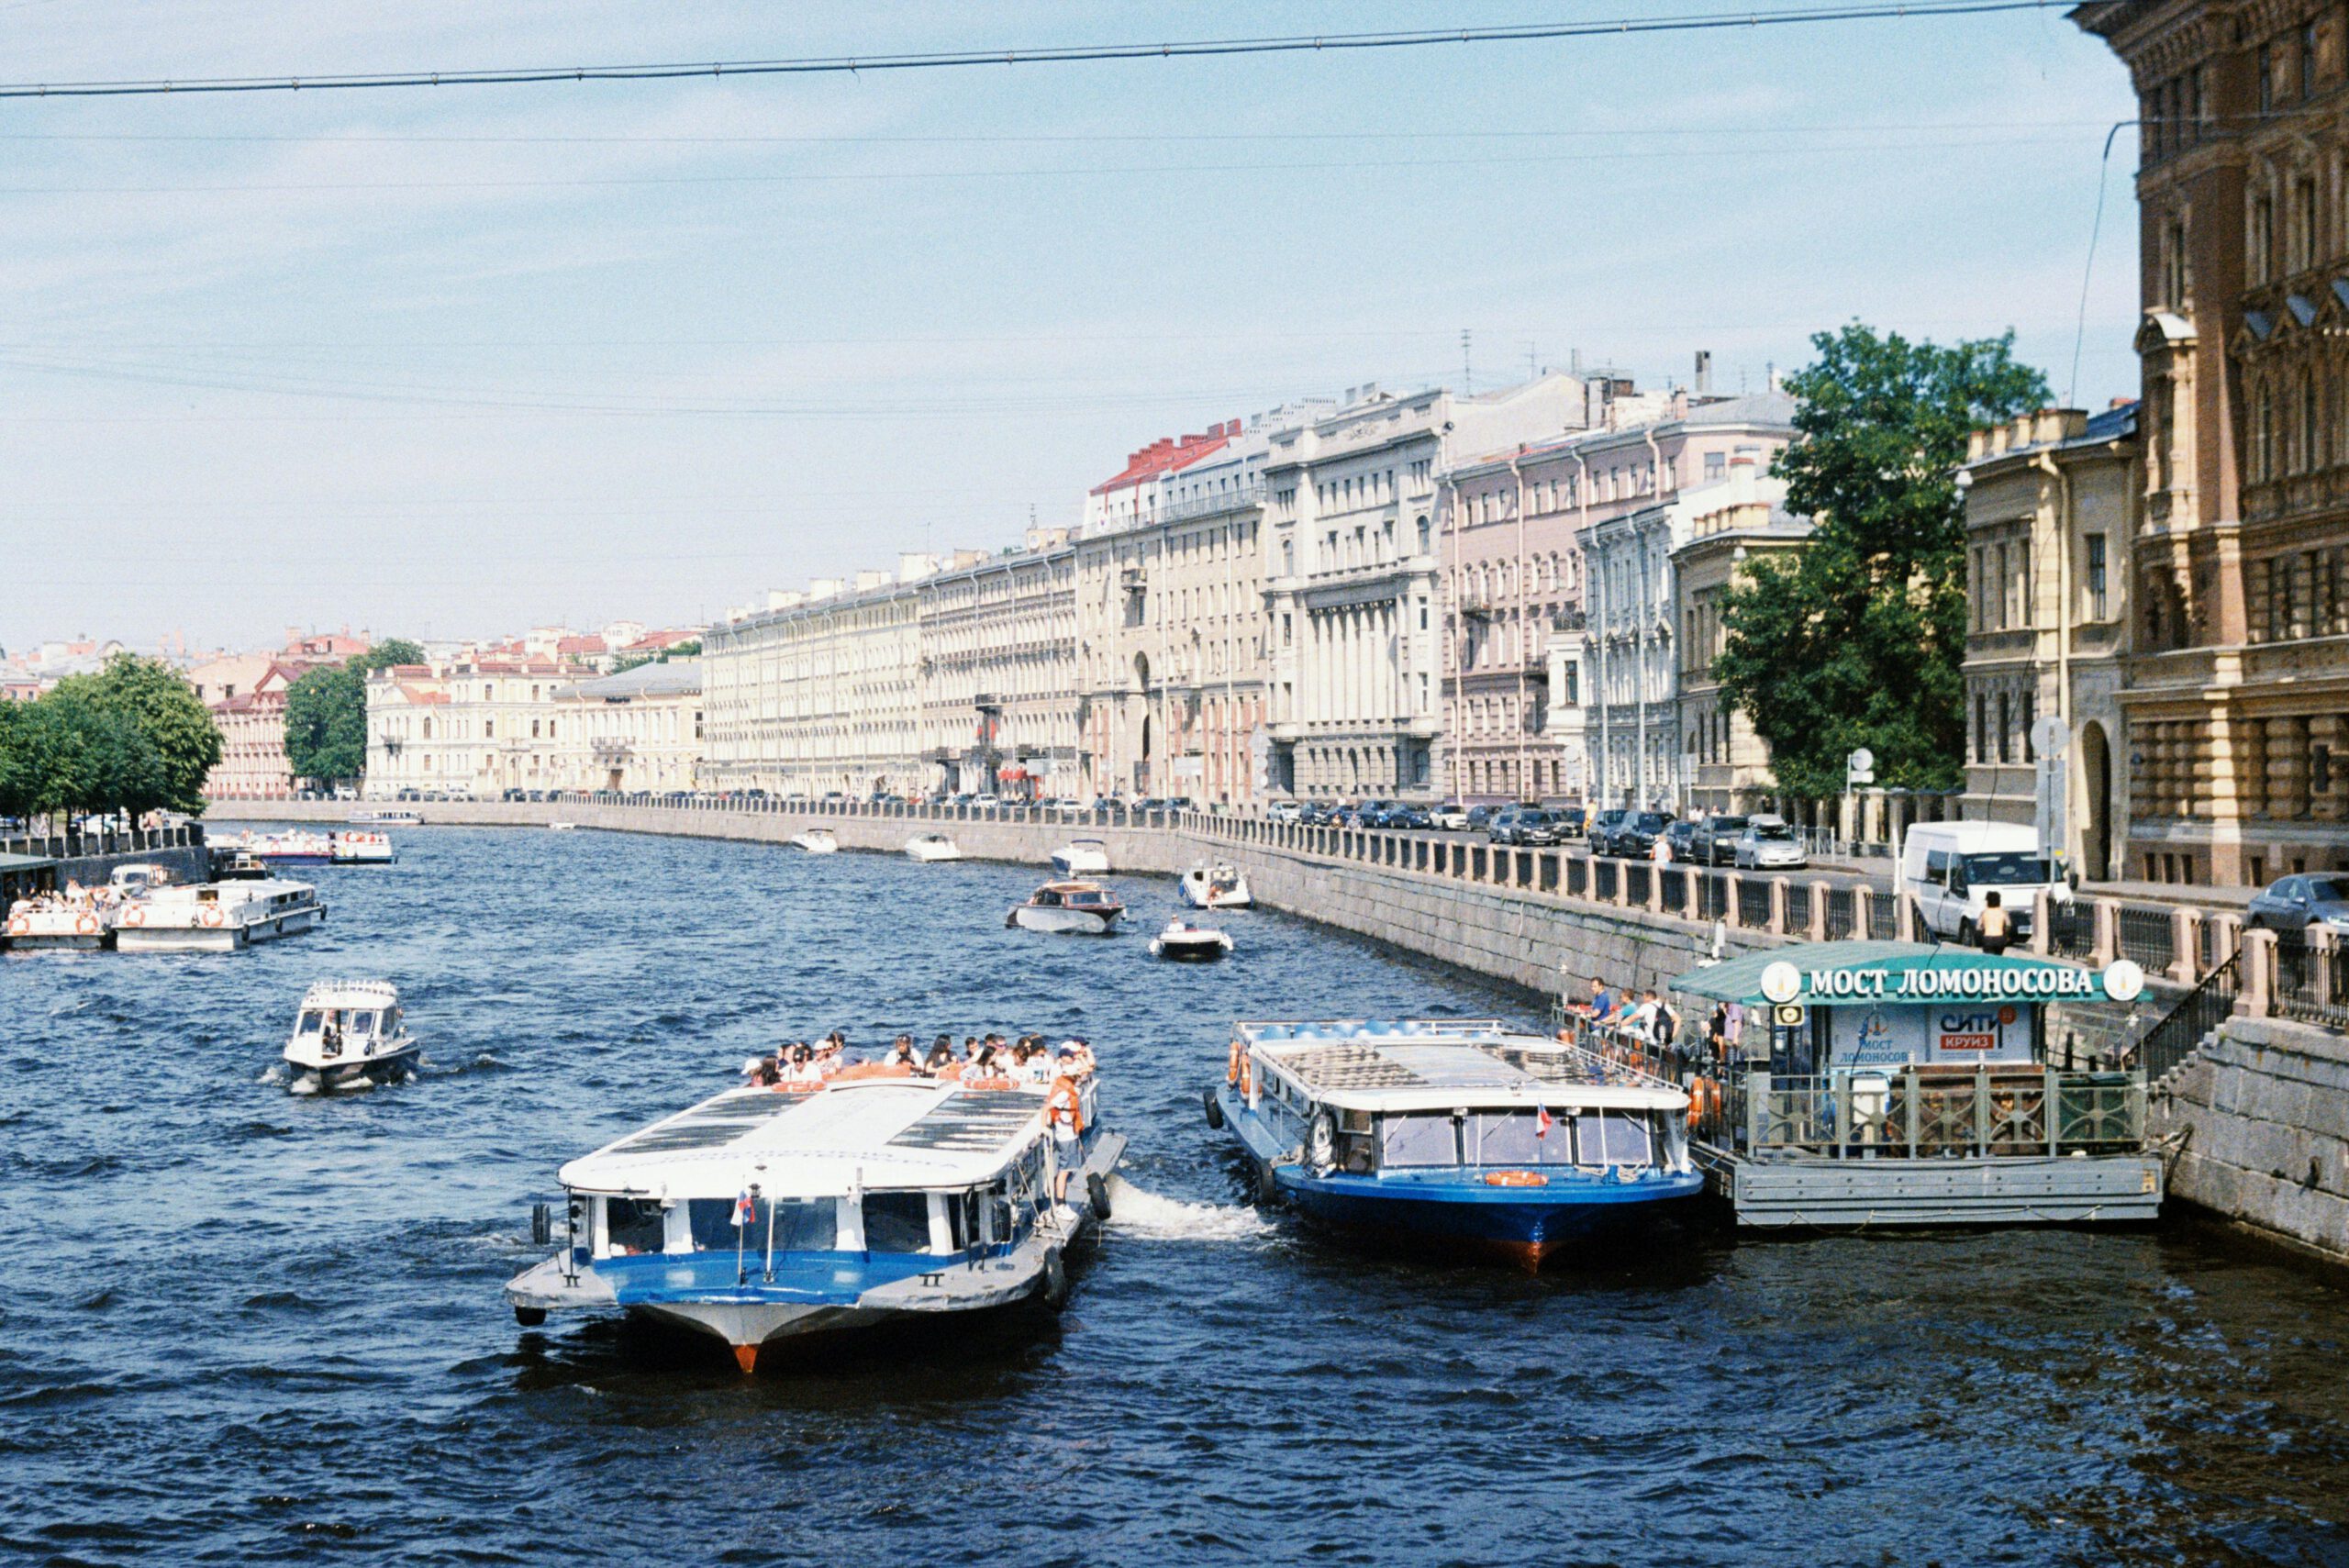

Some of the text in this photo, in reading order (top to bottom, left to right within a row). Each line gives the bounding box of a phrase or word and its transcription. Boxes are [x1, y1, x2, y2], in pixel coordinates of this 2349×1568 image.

[1809, 968, 2093, 995] МОСТ ЛОМОНОСОВА
[1863, 1040, 1893, 1051] МОСТ
[1945, 1037, 1989, 1047] КРУИЗ
[1840, 1051, 1913, 1062] ЛОМОНОСОВ
